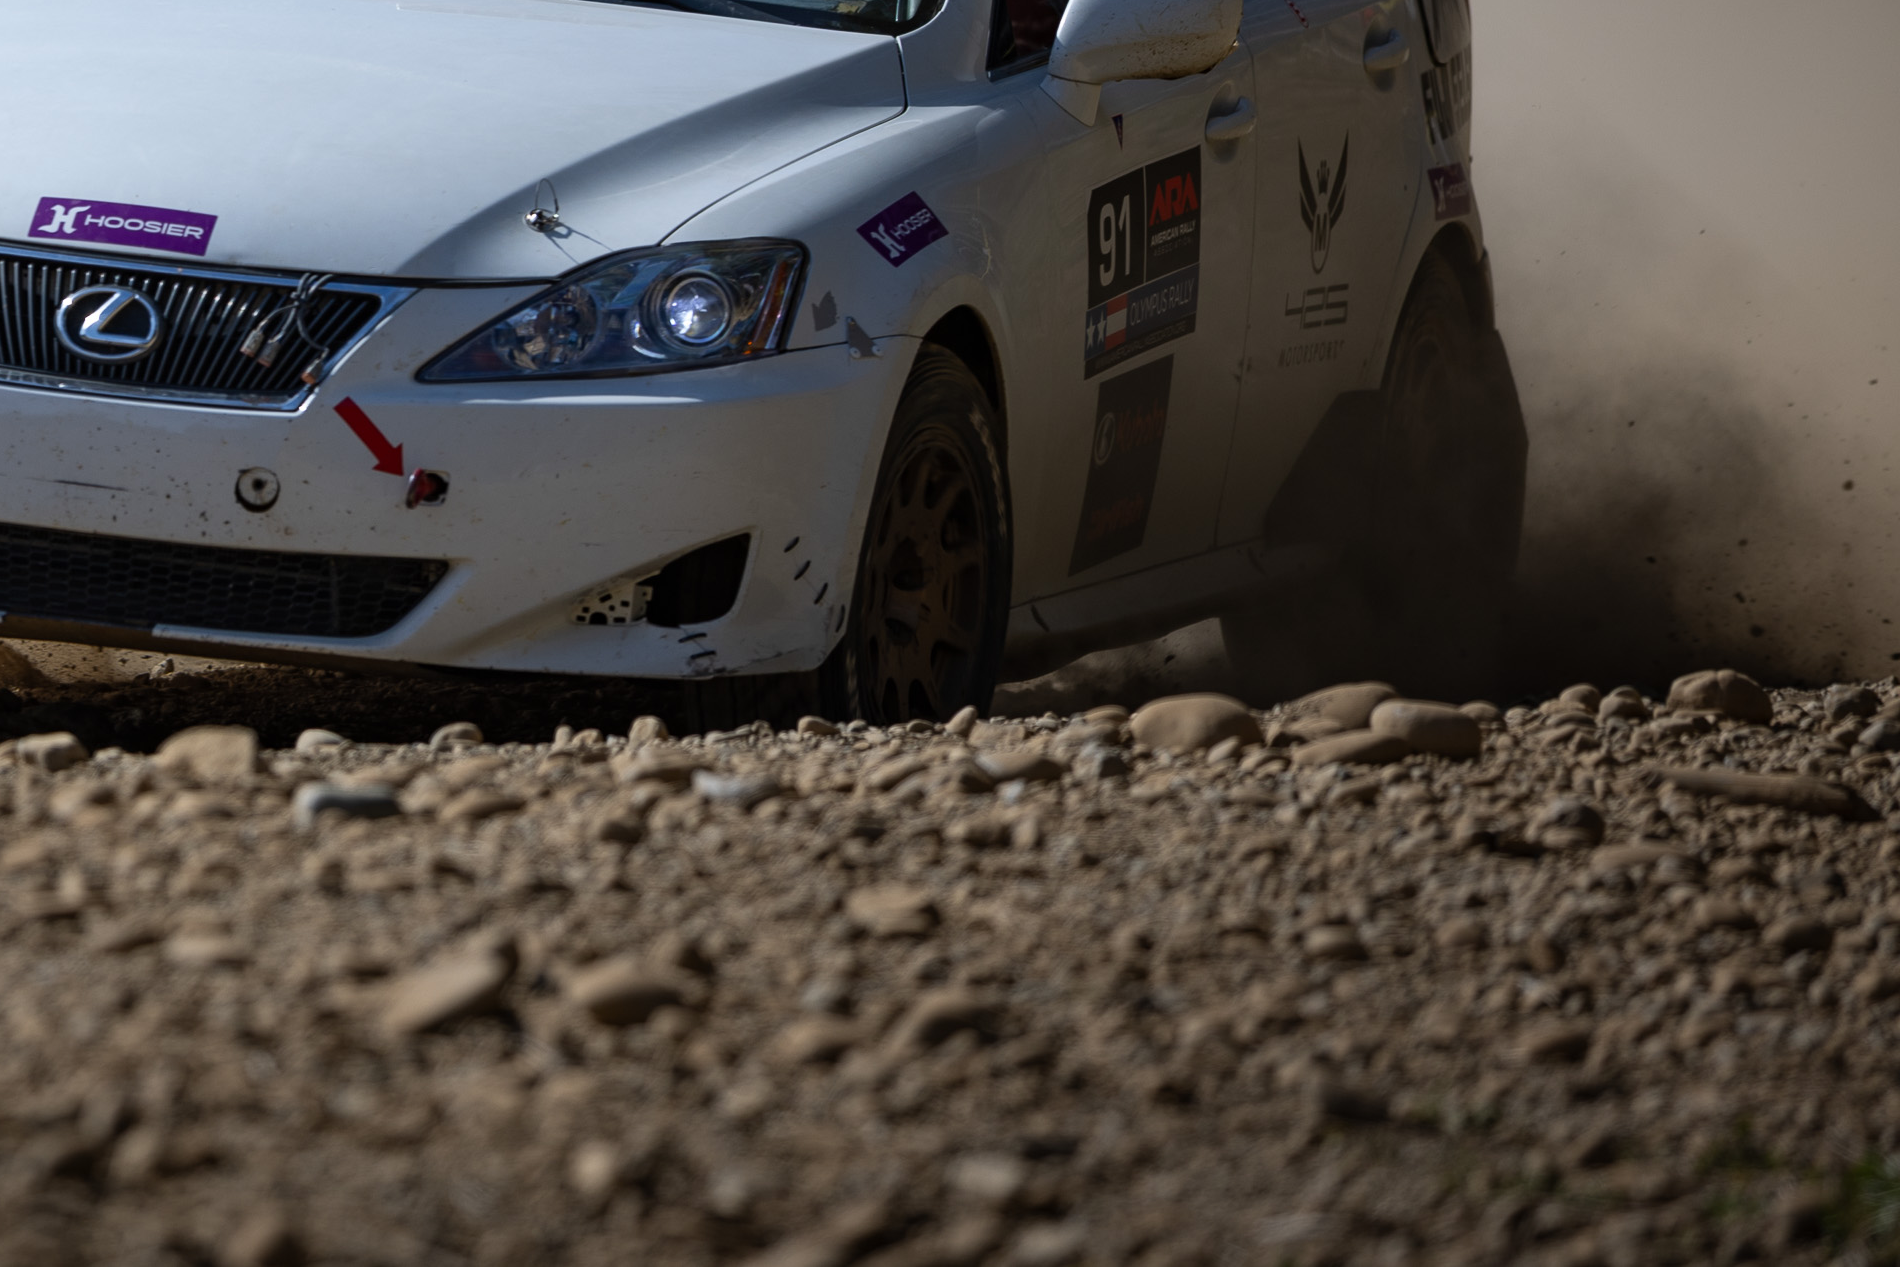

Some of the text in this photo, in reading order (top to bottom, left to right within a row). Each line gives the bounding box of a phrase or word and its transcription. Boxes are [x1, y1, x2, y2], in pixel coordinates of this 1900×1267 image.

[1148, 171, 1199, 227] ARA
[84, 214, 204, 240] HOOSIER
[889, 207, 935, 240] HOOSIER
[1099, 193, 1131, 287] 91
[1150, 218, 1197, 247] AMERICAN RALLY
[1129, 277, 1196, 326] OLYMPUS RALLY
[1284, 283, 1350, 330] 425
